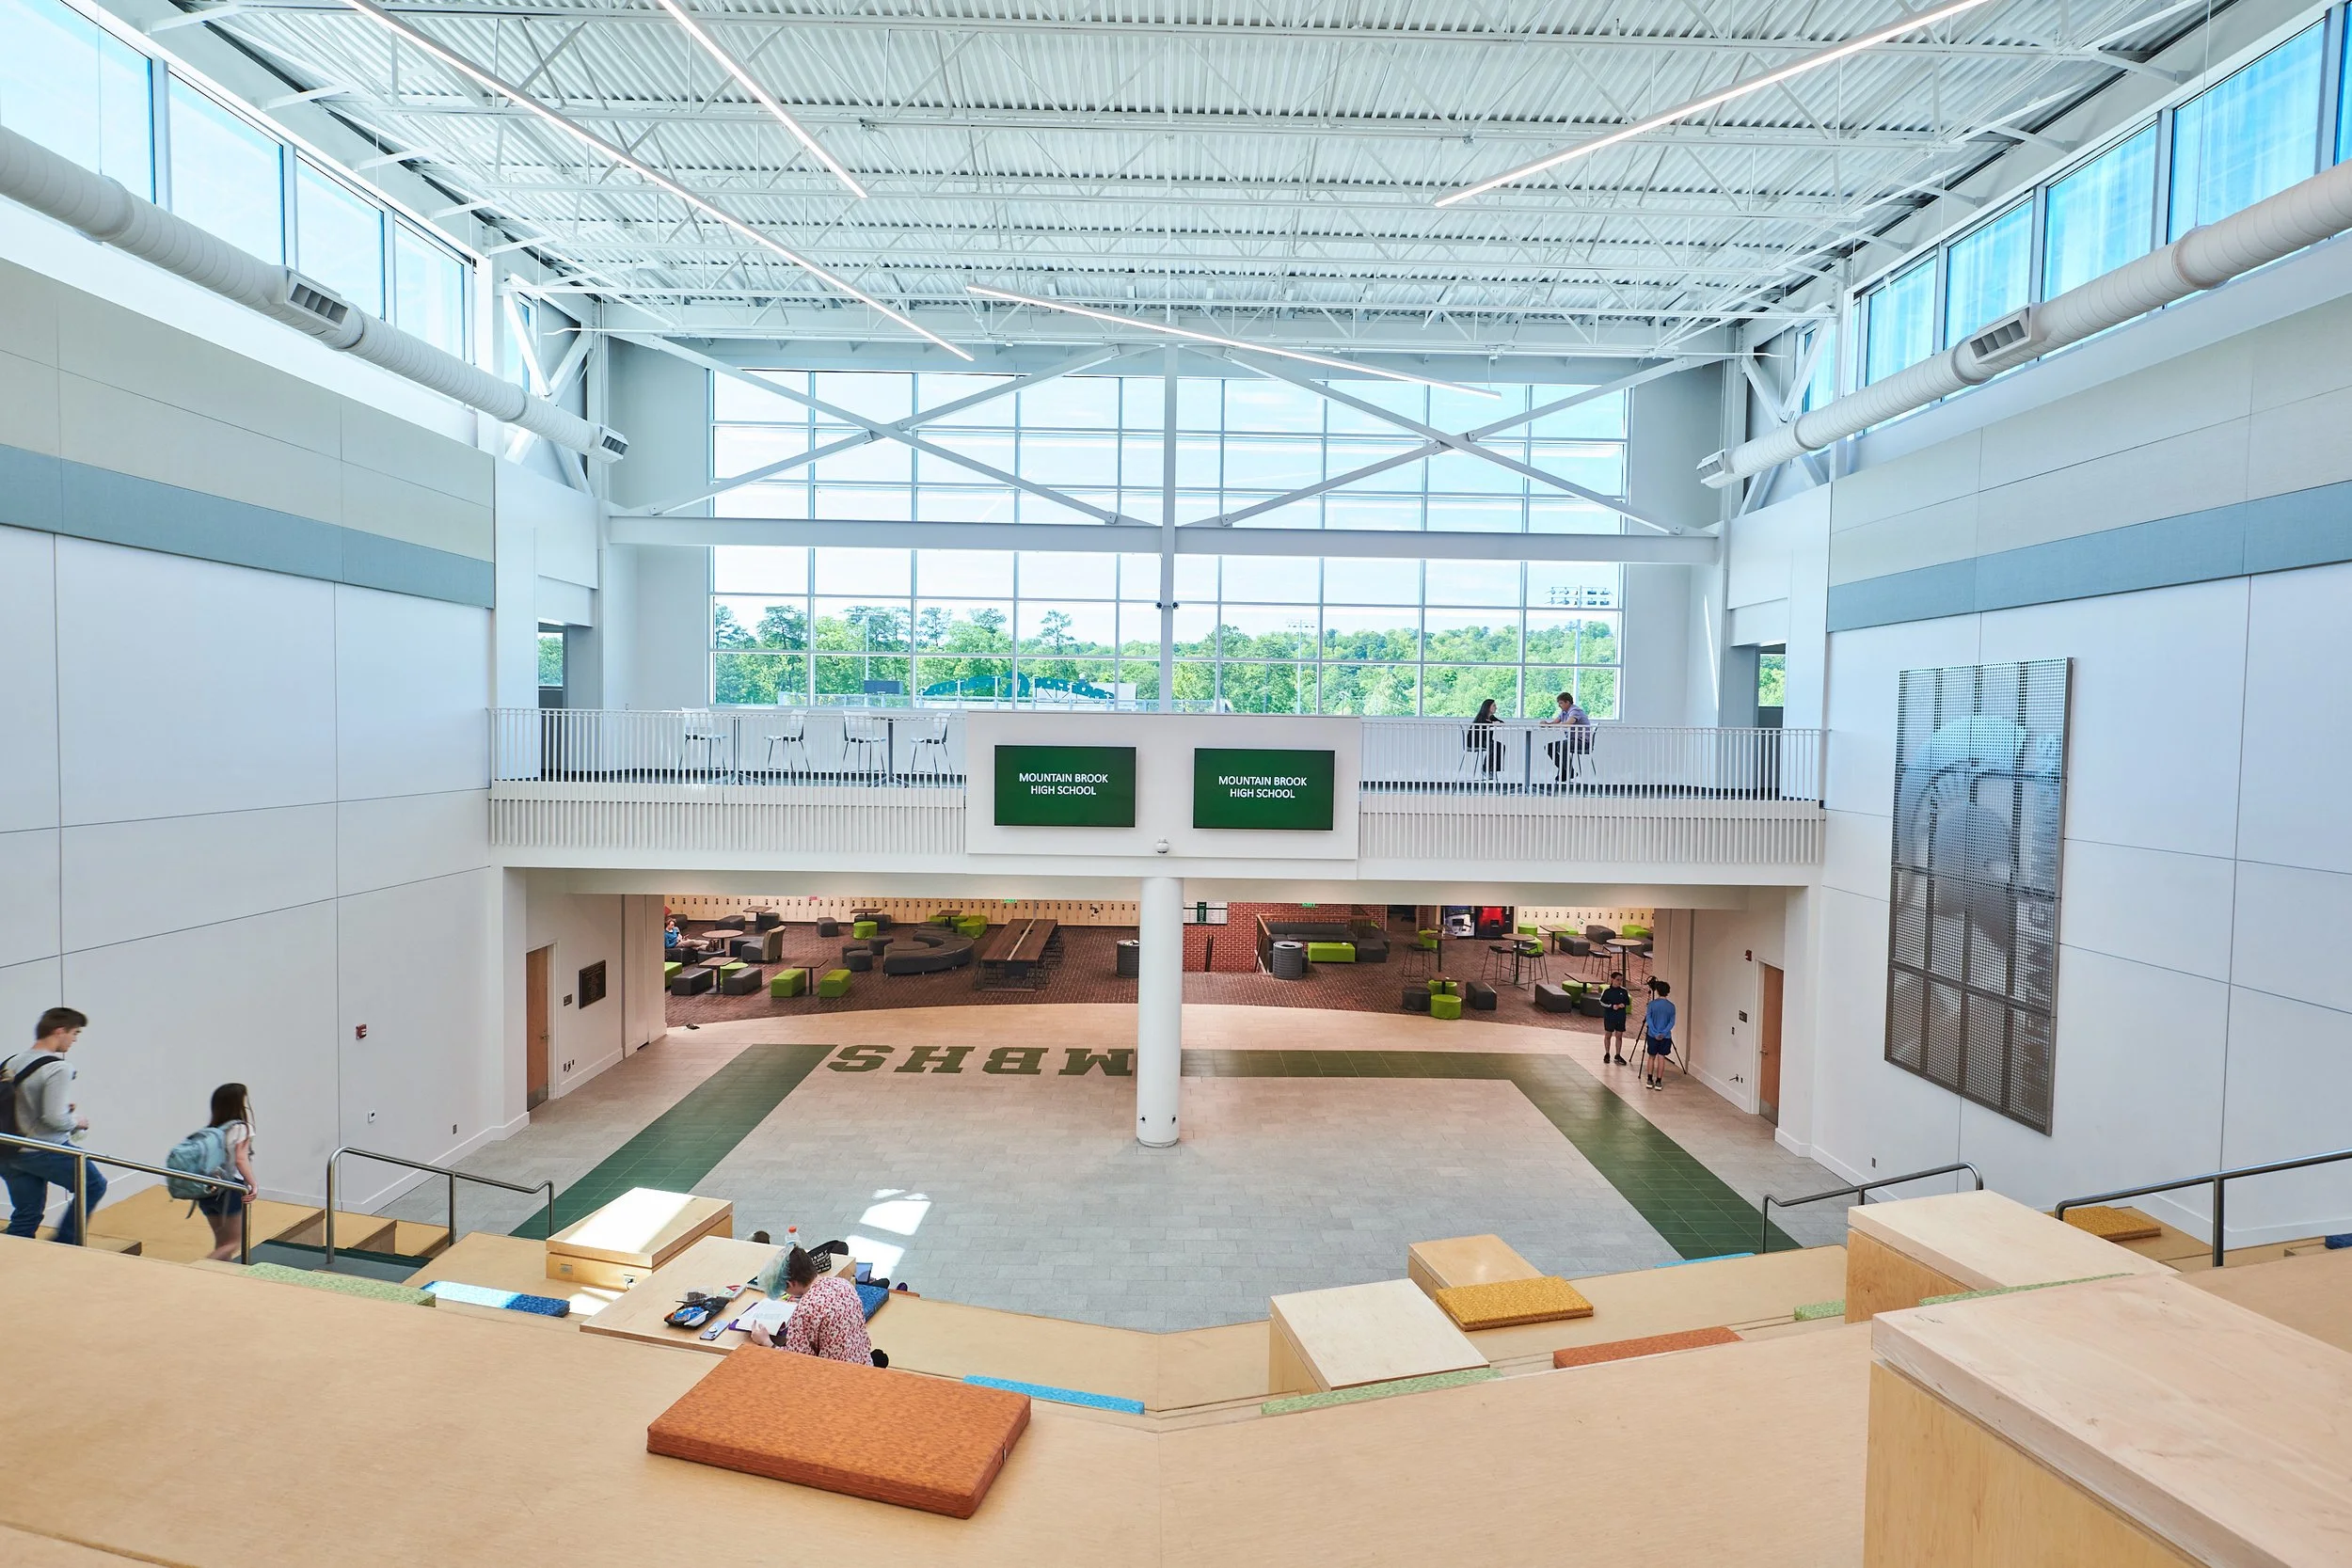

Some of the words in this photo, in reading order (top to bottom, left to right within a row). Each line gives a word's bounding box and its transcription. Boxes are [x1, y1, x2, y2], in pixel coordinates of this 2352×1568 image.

[1019, 772, 1073, 783] MOUNTAIN
[1074, 773, 1108, 784] BROOK
[1218, 775, 1271, 785] MOUNTAIN
[1273, 776, 1308, 786] BROOK
[1030, 784, 1056, 795] HIGH
[1057, 785, 1097, 796] SCHOOL
[1230, 788, 1254, 798] HIGH
[1256, 788, 1295, 799] SCHOOL
[827, 1044, 1135, 1076] MBHS
